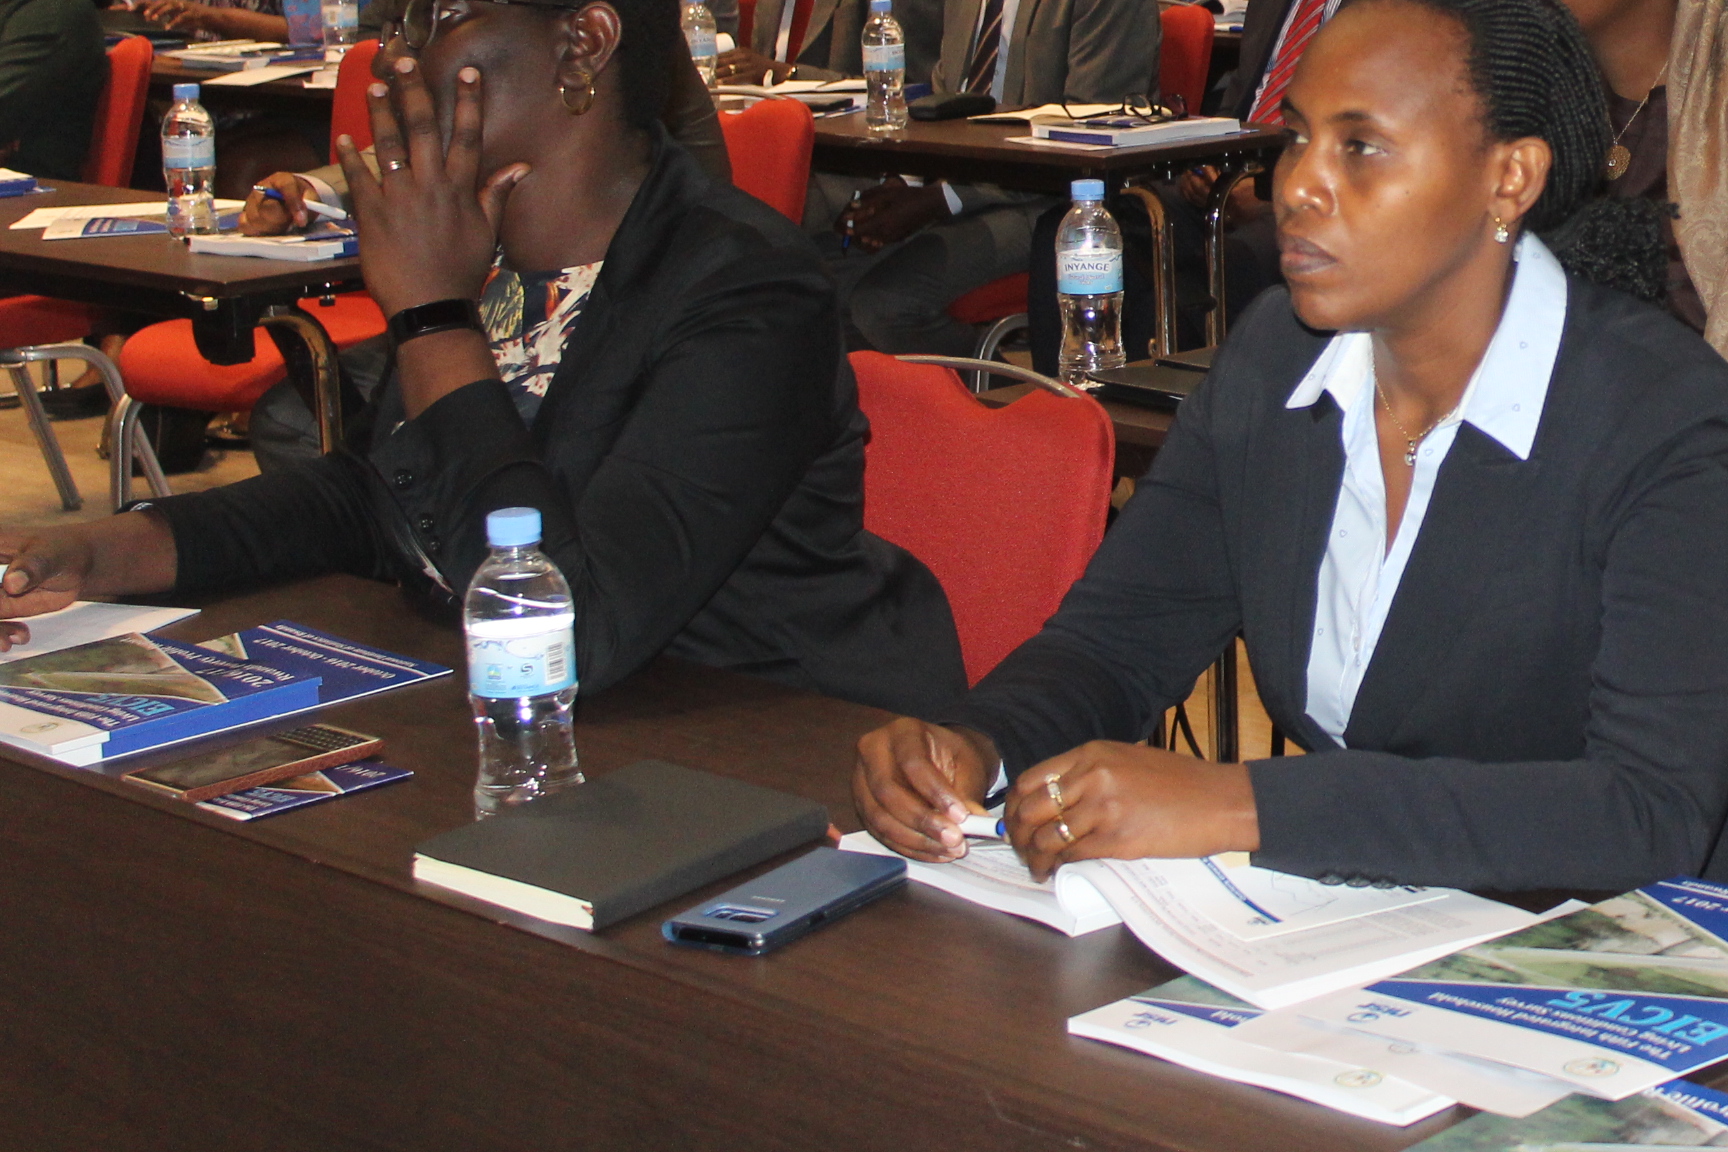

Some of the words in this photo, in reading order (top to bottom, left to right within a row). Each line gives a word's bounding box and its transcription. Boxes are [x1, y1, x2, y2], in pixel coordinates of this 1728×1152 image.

[1064, 262, 1110, 272] INYANGE
[284, 646, 324, 661] October
[244, 663, 295, 683] Rwanda
[353, 664, 397, 680] October
[97, 716, 121, 728] The
[1671, 895, 1722, 911] 2017
[1428, 990, 1516, 1017] Household
[1495, 995, 1550, 1016] Survey
[1511, 1010, 1600, 1039] Integrated
[1550, 1009, 1639, 1038] Conditions
[1598, 1031, 1641, 1050] Fifth
[1637, 1029, 1693, 1054] Living
[1638, 1043, 1674, 1061] The
